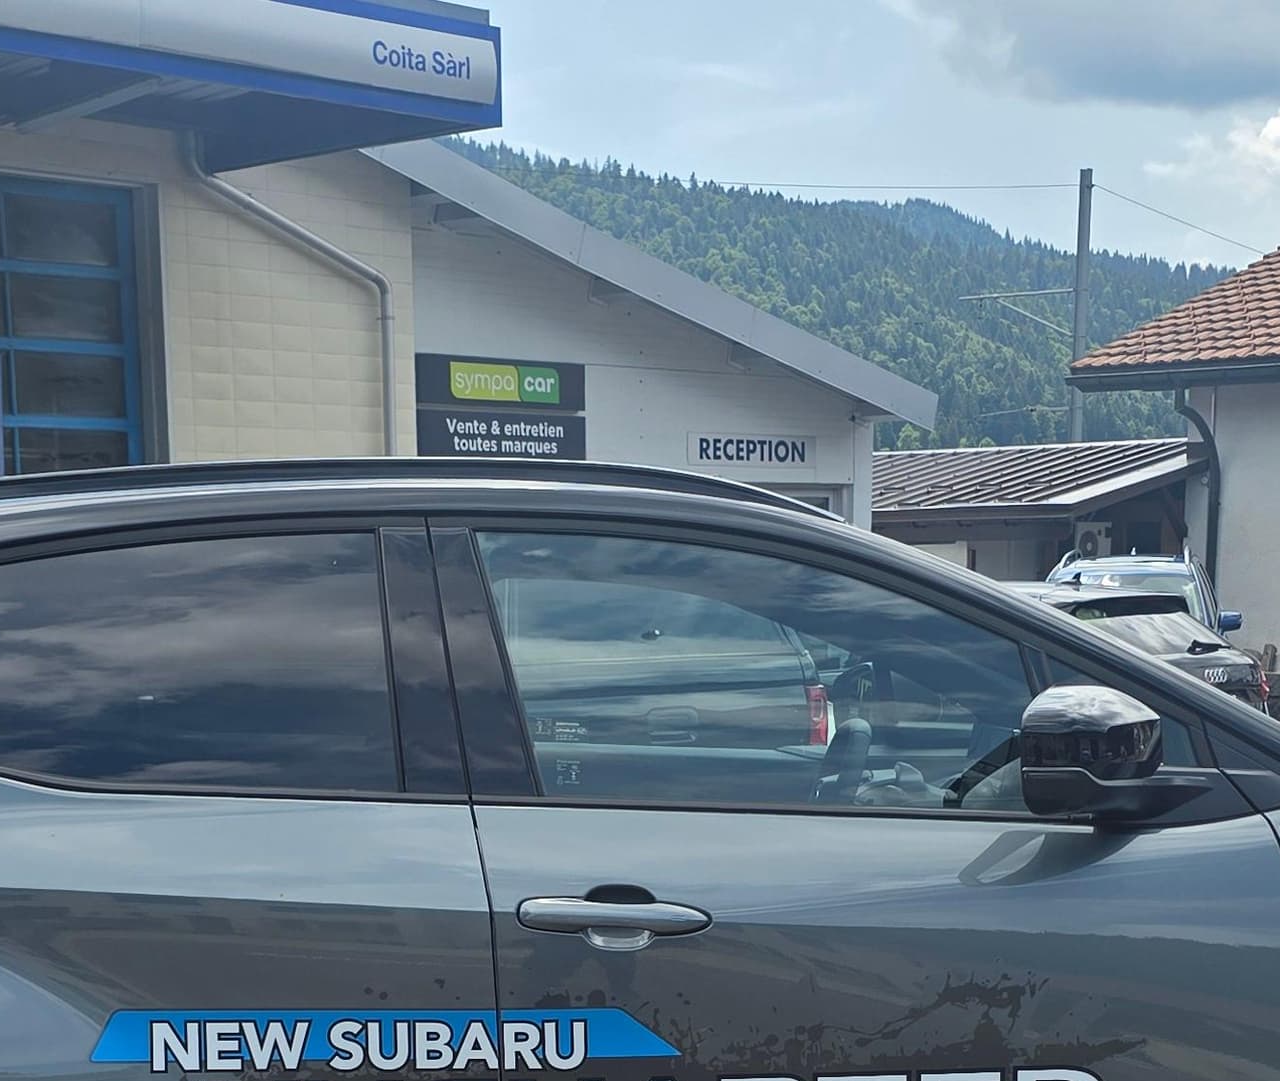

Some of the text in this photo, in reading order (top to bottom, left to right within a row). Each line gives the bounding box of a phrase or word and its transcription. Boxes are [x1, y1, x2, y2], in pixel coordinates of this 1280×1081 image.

[372, 40, 471, 80] Coita Sàrl
[454, 371, 556, 396] sympa car
[446, 418, 565, 438] Vente & entretien
[453, 435, 559, 456] toutes marques
[698, 437, 806, 463] RECEPTION
[150, 1020, 588, 1072] NEW SUBARU
